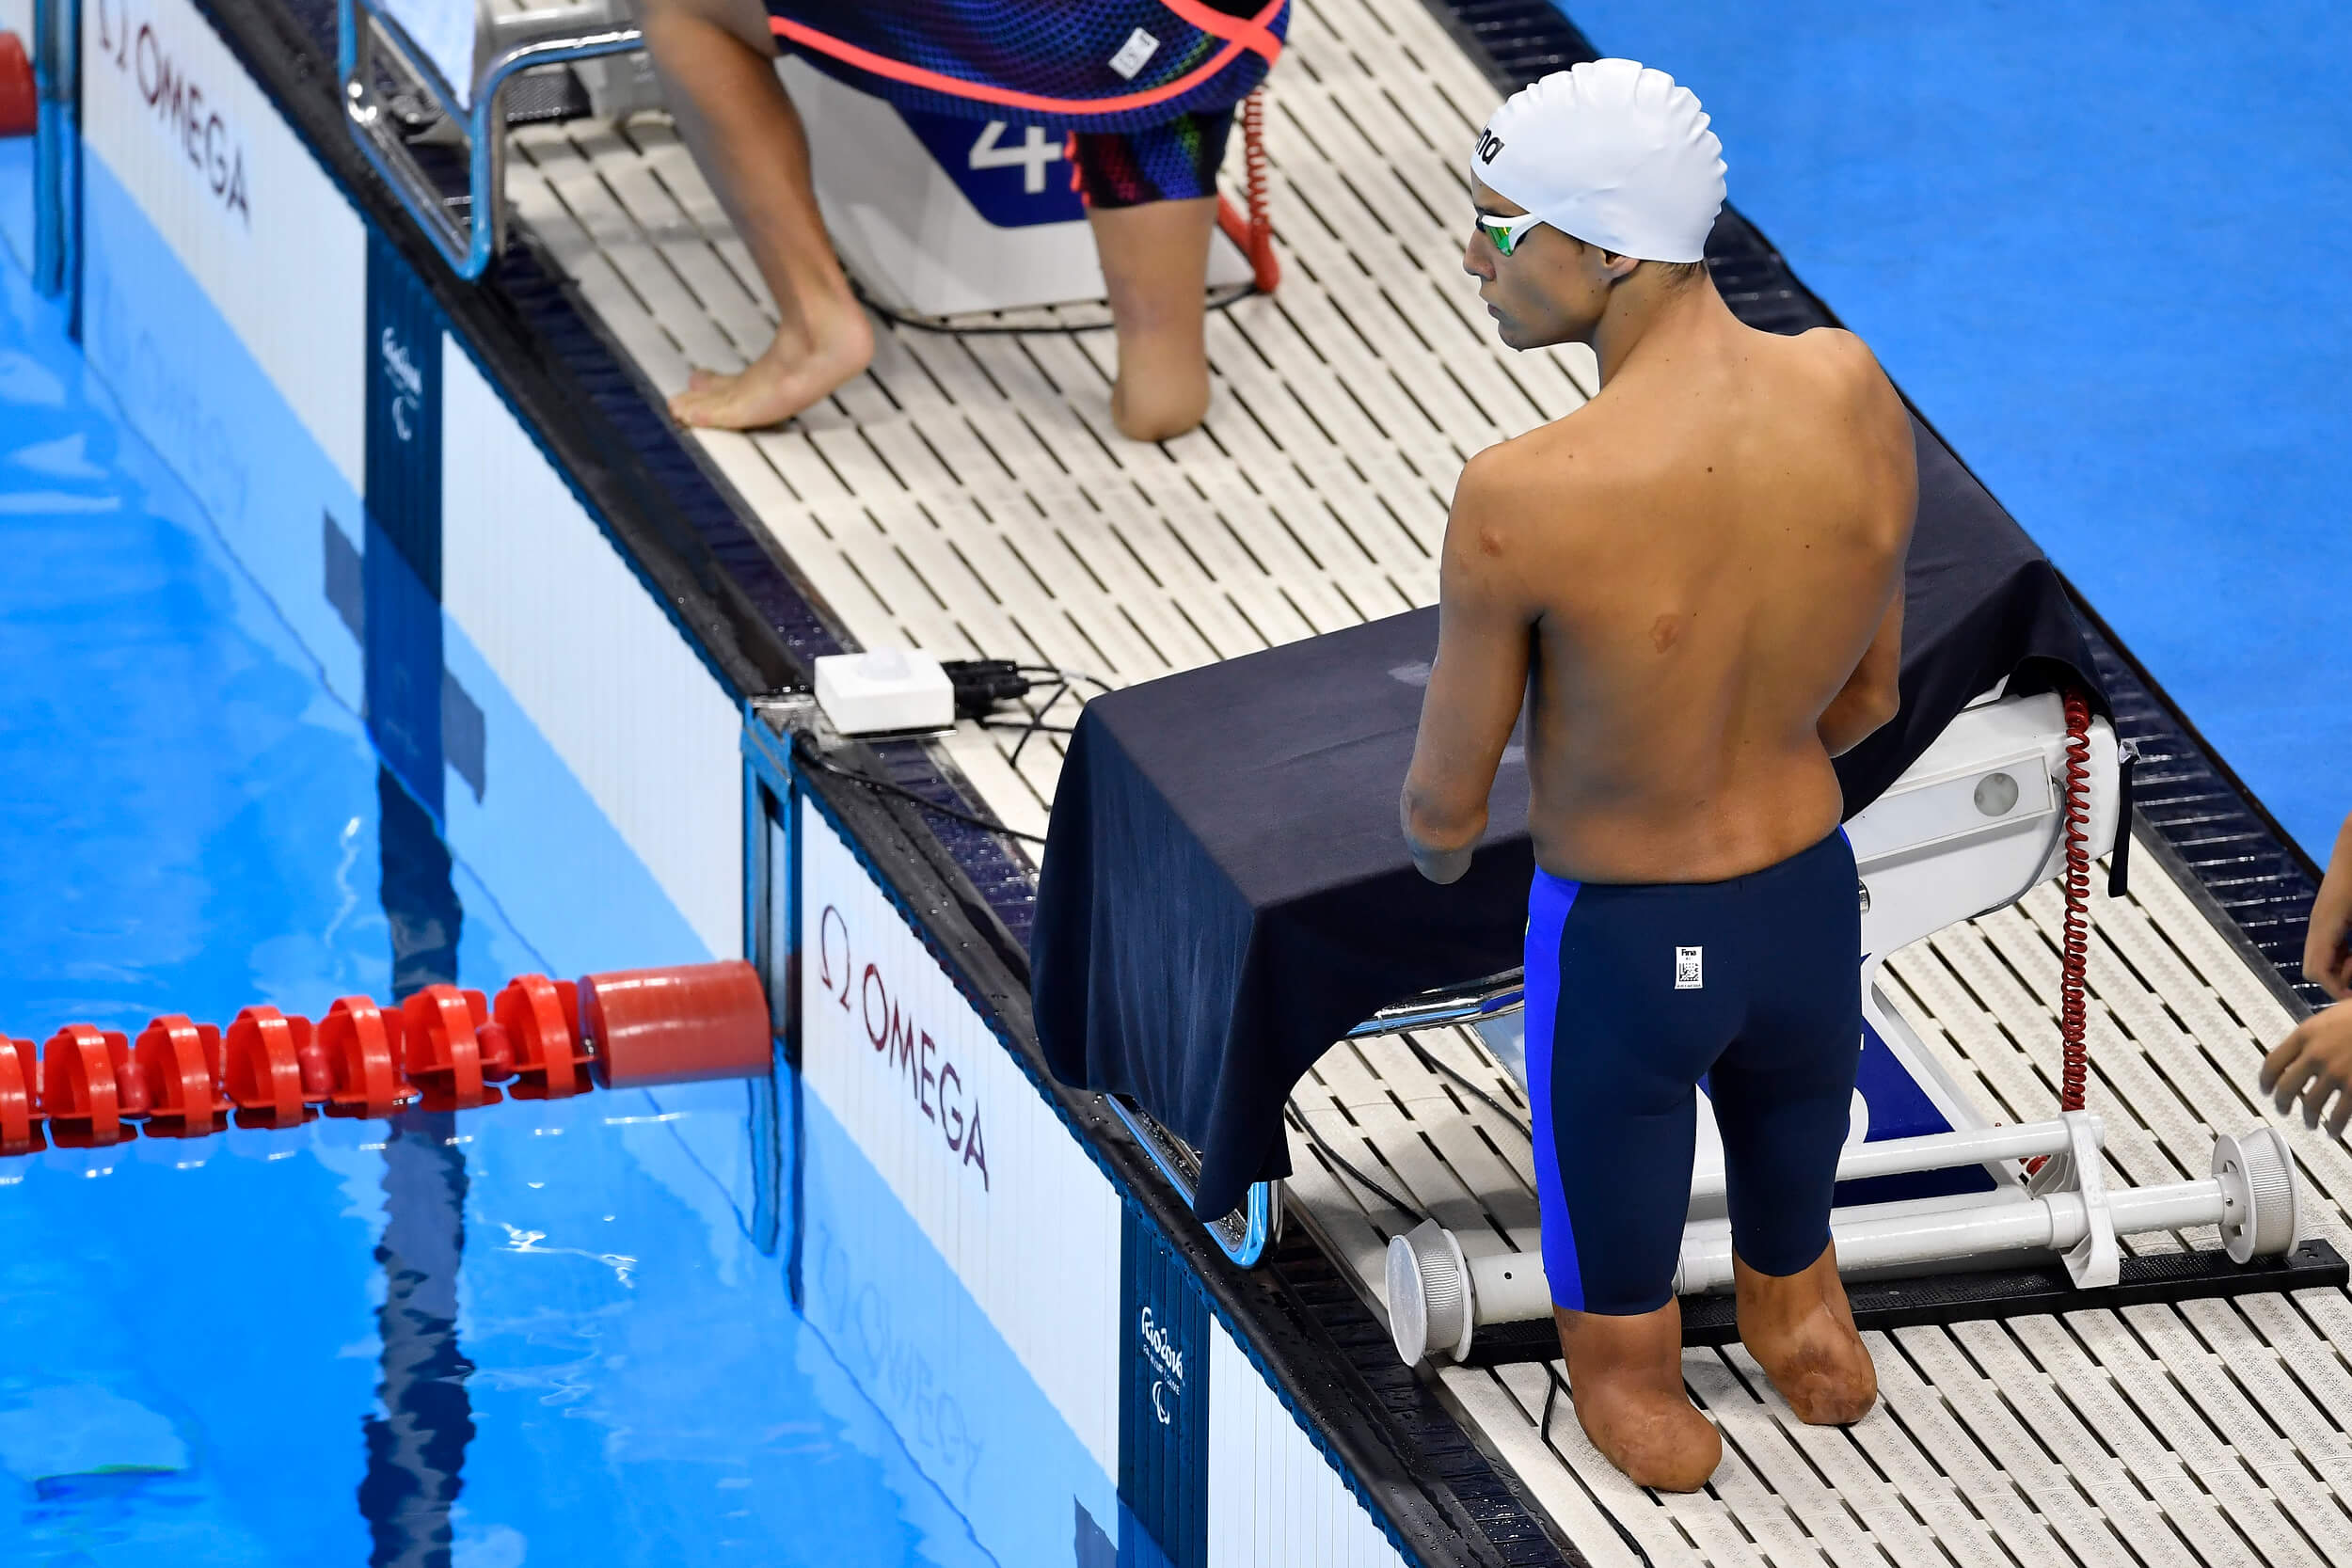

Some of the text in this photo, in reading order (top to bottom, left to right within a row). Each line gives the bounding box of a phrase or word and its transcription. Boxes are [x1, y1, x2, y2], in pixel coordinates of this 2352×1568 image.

[135, 22, 250, 231] OMEGA
[968, 119, 1062, 194] 4
[863, 962, 989, 1193] OMEGA
